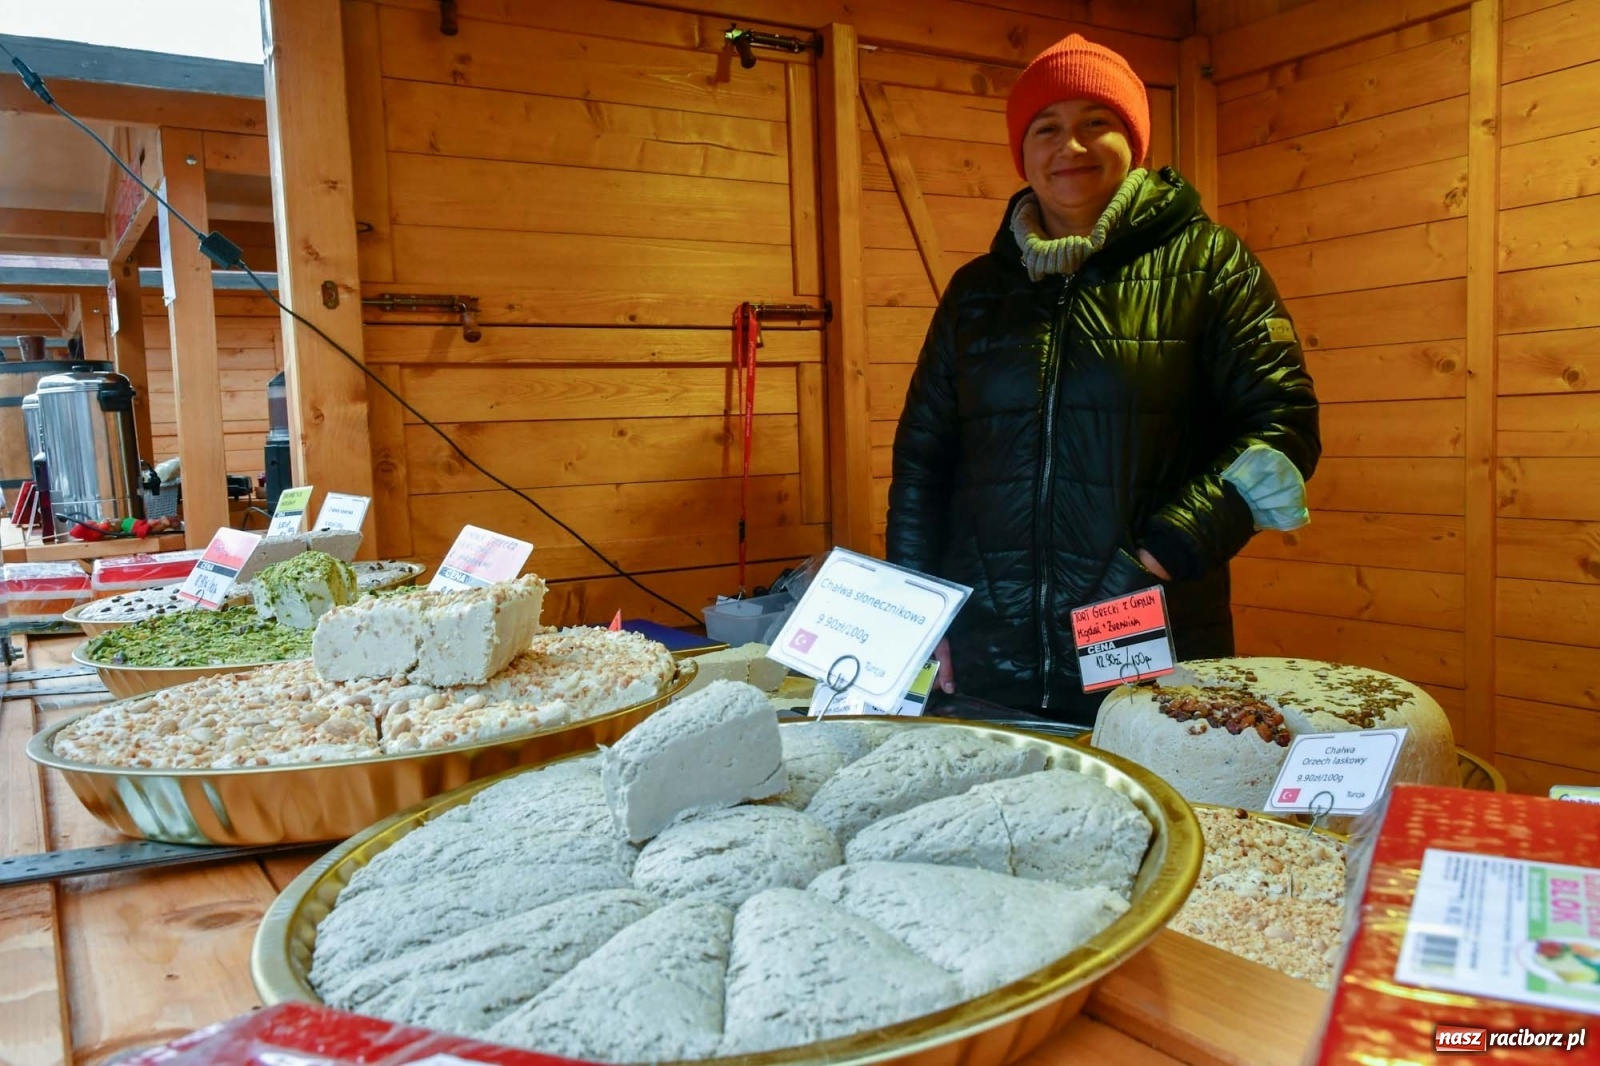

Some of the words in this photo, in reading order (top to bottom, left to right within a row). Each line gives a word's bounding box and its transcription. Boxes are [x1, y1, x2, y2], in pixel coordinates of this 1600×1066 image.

[444, 569, 467, 583] CENA
[820, 577, 853, 598] Chałwa
[855, 587, 926, 625] słonecznikowa
[1087, 641, 1116, 654] CENA
[864, 660, 887, 678] Turcja
[1325, 746, 1356, 755] Chałwa
[1302, 757, 1331, 766] Orzech
[1332, 756, 1368, 766] laskowy
[1346, 791, 1365, 799] Turcja
[1551, 877, 1582, 924] BLOK
